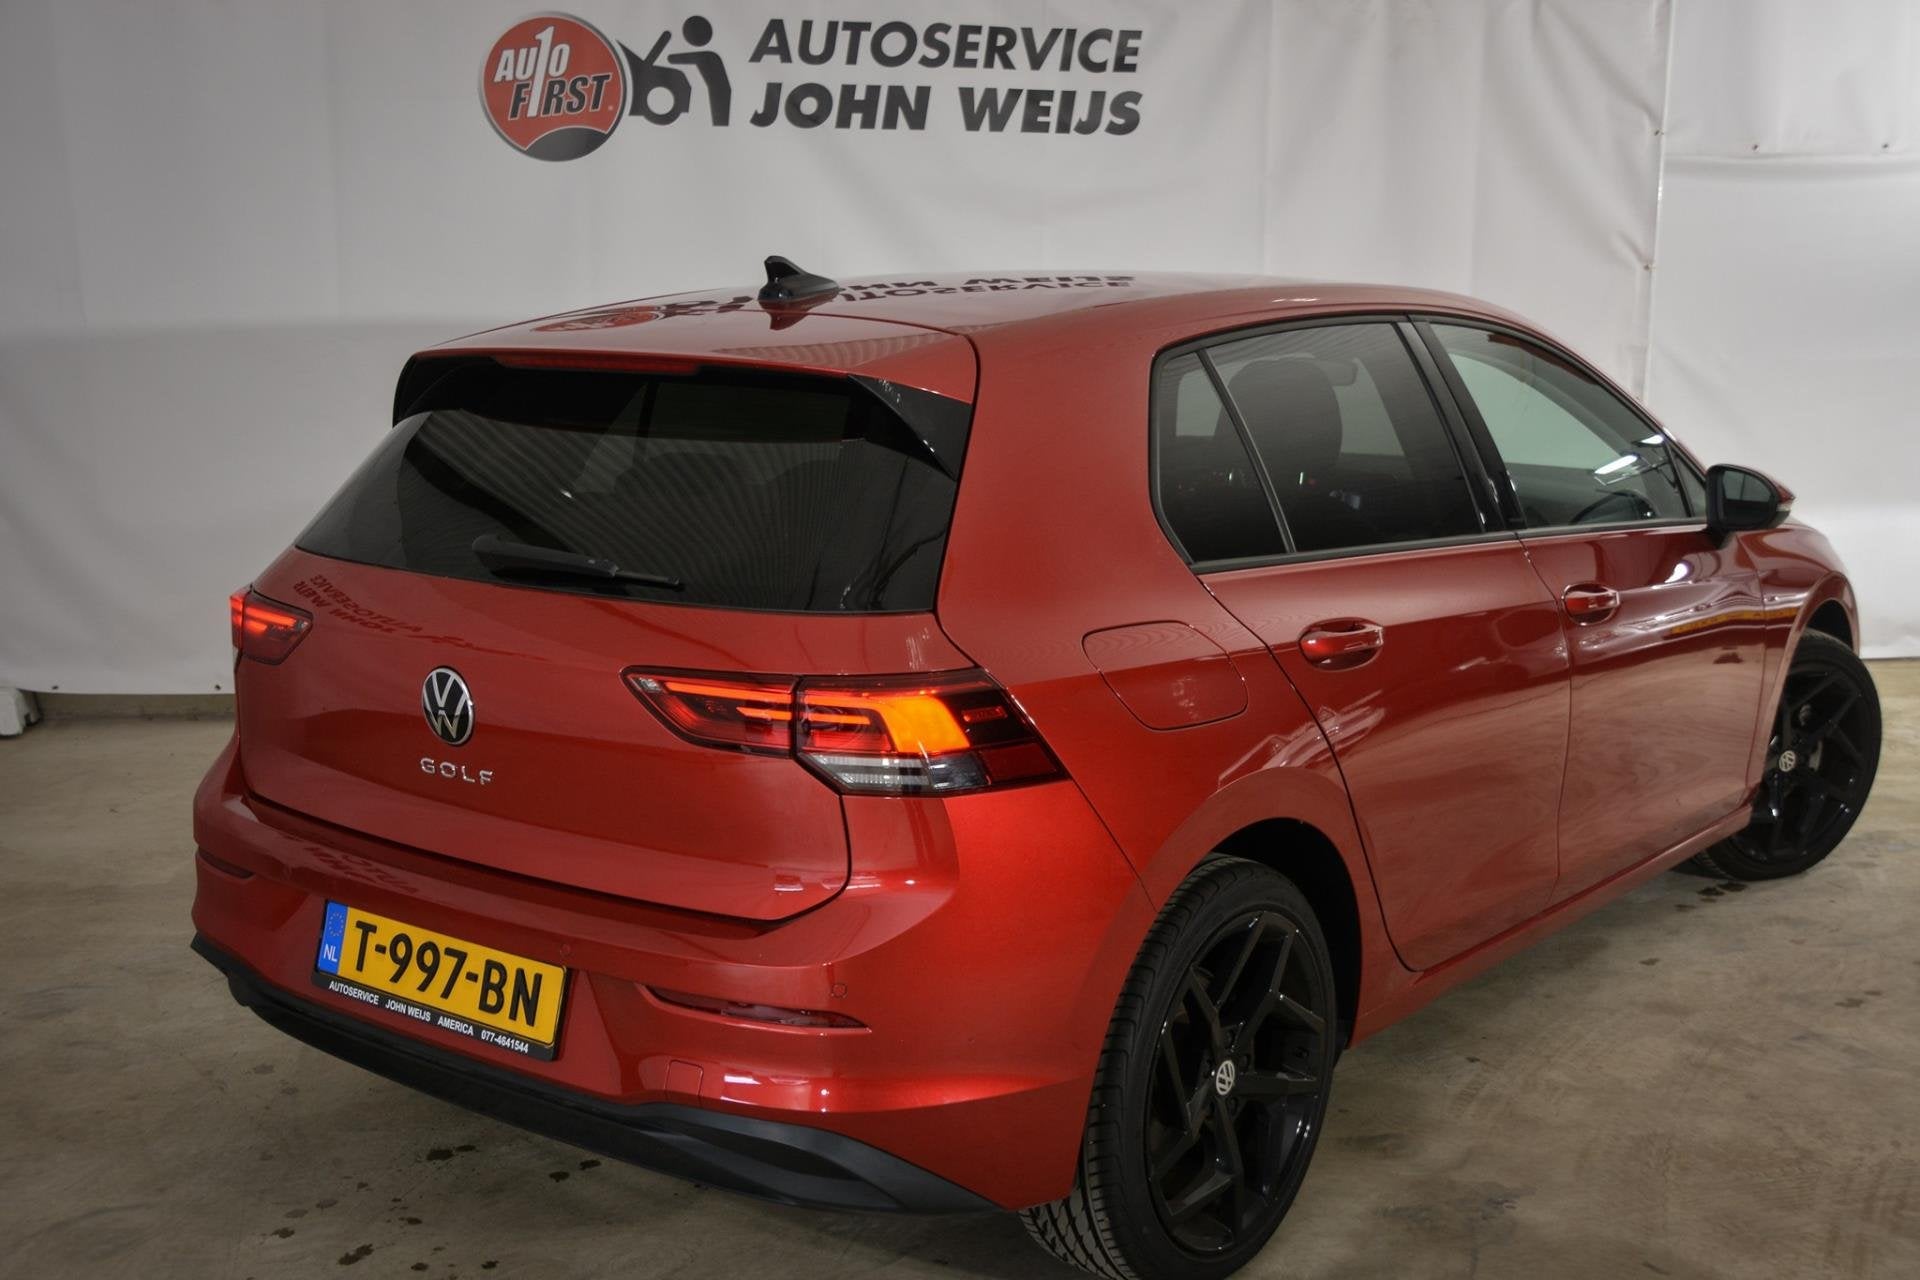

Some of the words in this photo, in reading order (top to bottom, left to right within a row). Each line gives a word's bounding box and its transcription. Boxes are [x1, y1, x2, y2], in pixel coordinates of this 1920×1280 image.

[748, 18, 1143, 73] AUTOSERVICE
[749, 82, 932, 129] JOHN
[958, 86, 1143, 135] WEIJS
[420, 757, 493, 785] GOLF
[323, 943, 338, 963] NL
[355, 920, 543, 1028] T-997-BN
[329, 980, 379, 1006] AUTOSERVICE
[385, 999, 407, 1014] JOHN
[407, 1005, 431, 1022] WEIJS
[437, 1015, 474, 1036] AMERICA
[481, 1029, 529, 1054] 077-4641544
